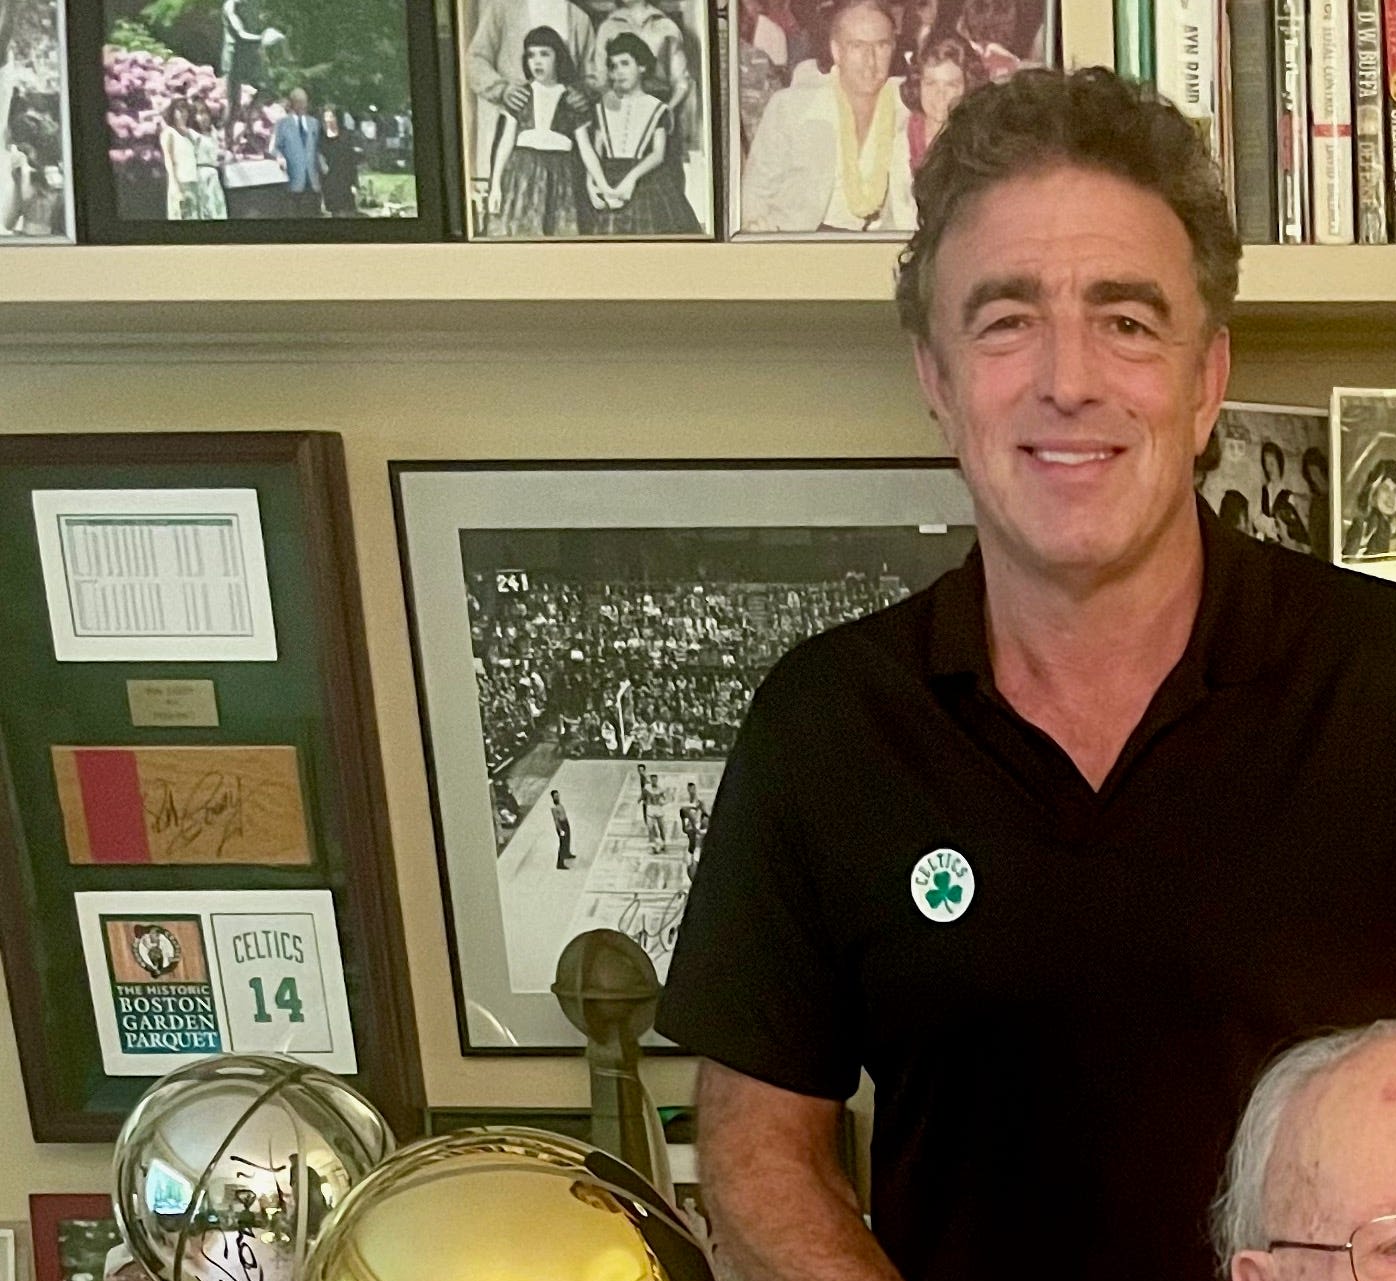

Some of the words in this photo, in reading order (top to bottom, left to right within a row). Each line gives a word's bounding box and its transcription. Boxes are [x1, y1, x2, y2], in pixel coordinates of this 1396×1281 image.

[1184, 24, 1199, 55] AYN
[1184, 61, 1200, 105] RAND
[1358, 51, 1378, 98] BUFFA
[915, 852, 968, 886] CELTICS
[233, 930, 305, 964] CELTICS
[117, 985, 143, 995] THE
[147, 985, 210, 996] HISTORIC
[119, 996, 213, 1013] BOSTON
[248, 976, 305, 1023] 14
[122, 1013, 216, 1031] GARDEN
[125, 1031, 218, 1051] PARQUET
